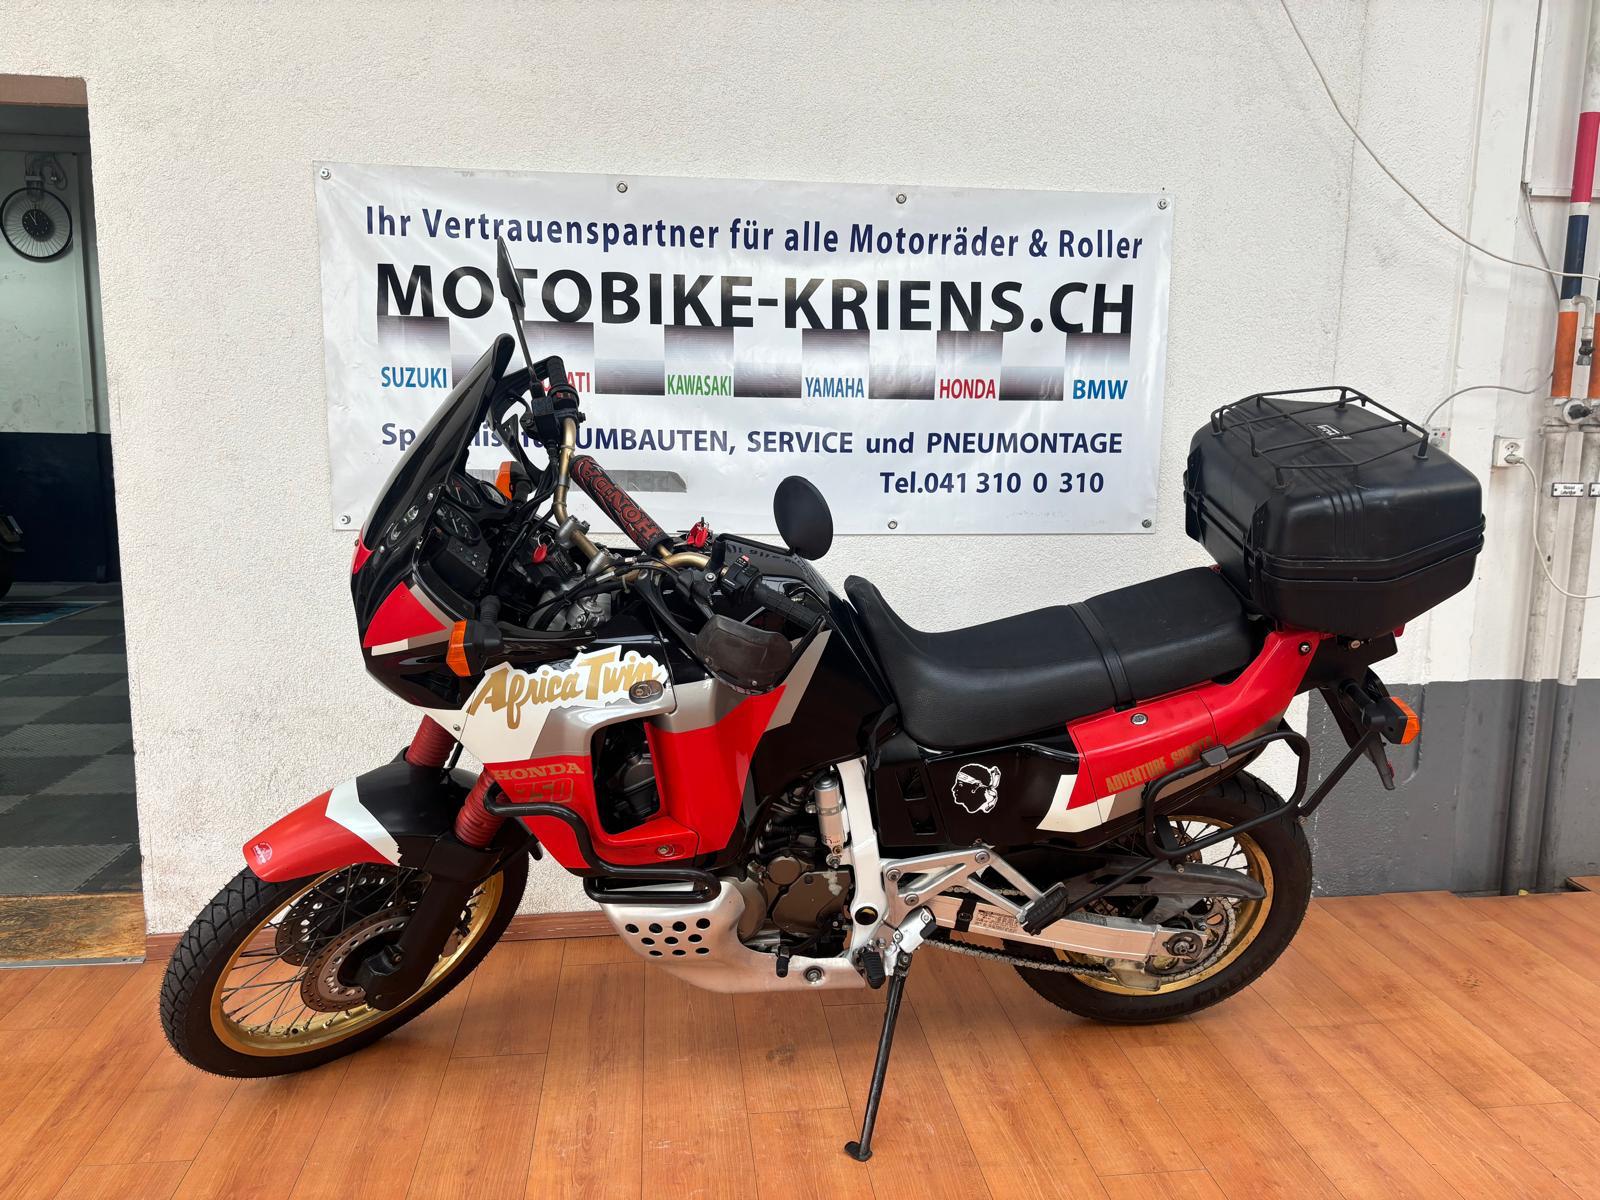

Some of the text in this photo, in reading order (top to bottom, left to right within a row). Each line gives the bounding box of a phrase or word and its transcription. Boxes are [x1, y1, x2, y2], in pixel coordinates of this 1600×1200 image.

[366, 205, 1143, 259] Ihr Vertrauenspartner für alle Motorräder & Roller
[376, 262, 1134, 334] MOTOBIKE-KRIENS.CH
[381, 366, 447, 389] SUZUKI
[667, 375, 732, 396] KAWASAKI
[805, 377, 865, 398] YAMAHA
[939, 379, 996, 400] HONDA
[1072, 379, 1128, 400] BMW
[574, 427, 736, 456] UMBAUTEN,
[747, 430, 853, 454] SERVICE
[866, 431, 915, 454] und
[926, 432, 1123, 454] PNEUMONTAGE
[880, 471, 1104, 494] Tel.041 310 0 310
[579, 461, 658, 541] HONDA
[466, 651, 662, 729] Africa Twin
[490, 763, 585, 781] HONDA
[1105, 757, 1168, 793] ADVENTURE
